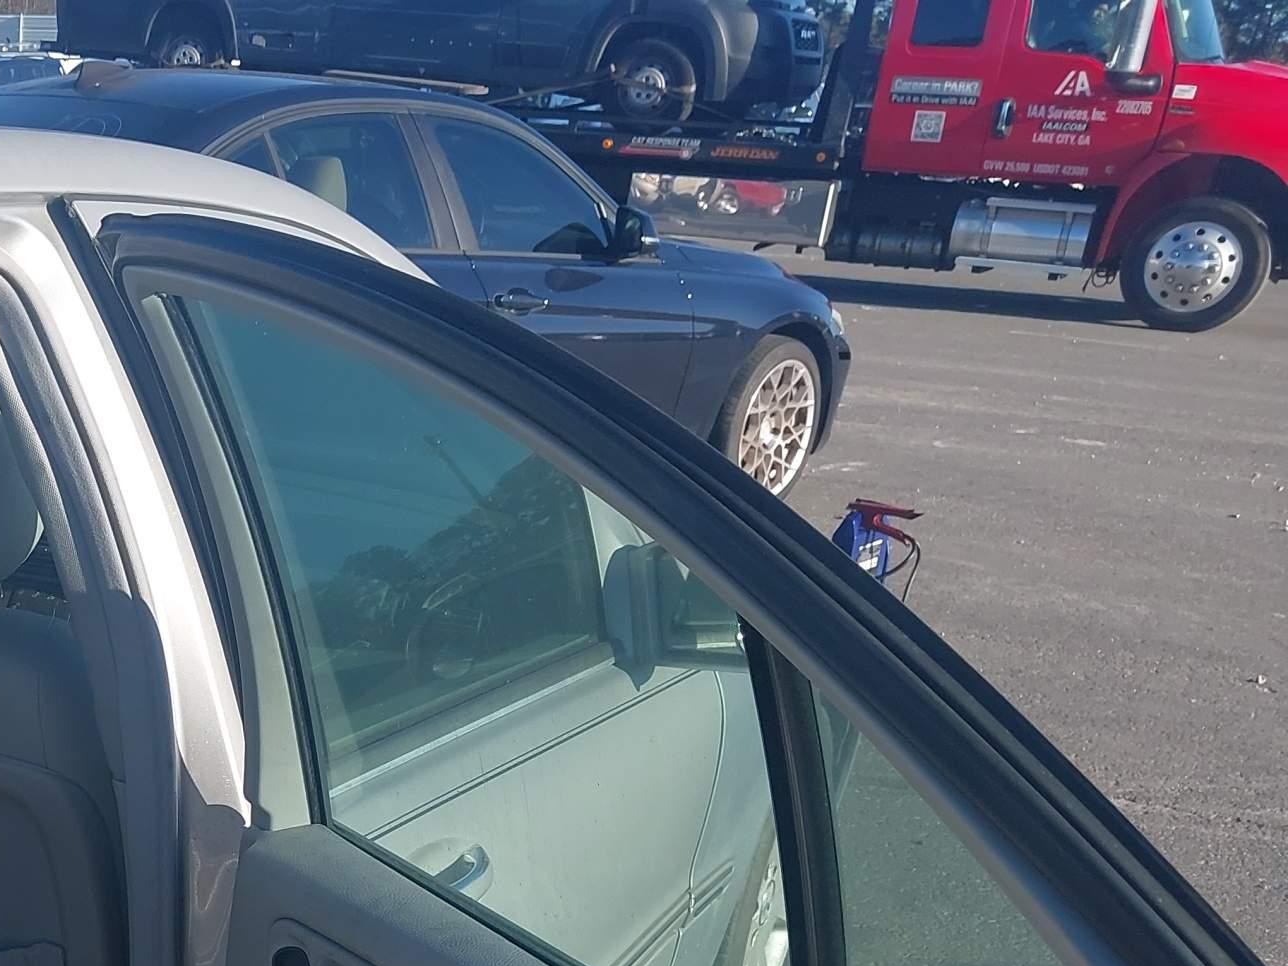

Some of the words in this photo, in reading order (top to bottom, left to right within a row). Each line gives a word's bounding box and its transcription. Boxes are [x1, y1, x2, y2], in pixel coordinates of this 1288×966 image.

[943, 80, 979, 94] PARK?
[1027, 104, 1045, 119] IAA
[1047, 105, 1089, 122] Services,
[1032, 132, 1054, 145] LAKE
[1078, 134, 1091, 146] GA
[983, 159, 1005, 171] GVW
